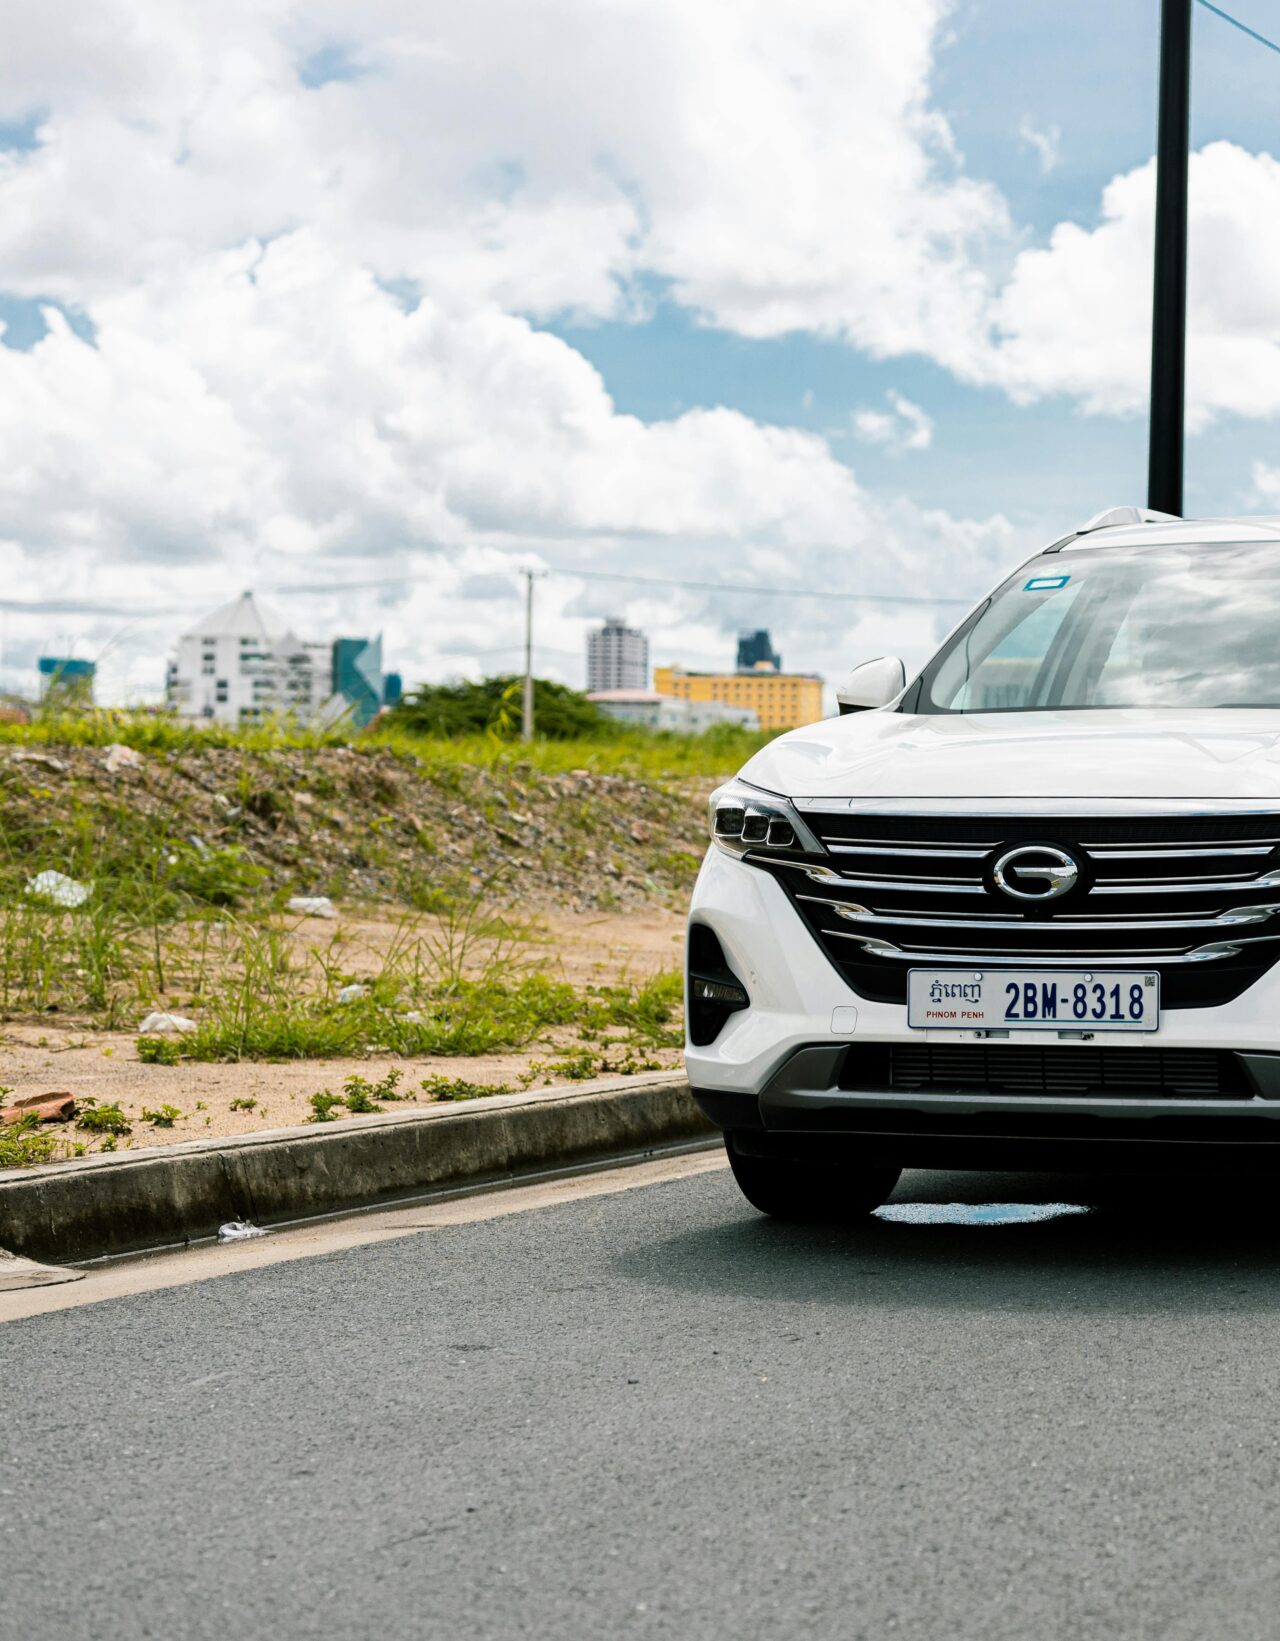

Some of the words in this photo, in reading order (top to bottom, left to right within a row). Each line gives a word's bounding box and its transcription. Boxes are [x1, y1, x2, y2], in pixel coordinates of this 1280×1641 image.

[1004, 982, 1144, 1020] 2BM-8318
[926, 1010, 957, 1019] PHNOM
[961, 1011, 984, 1019] PENH
